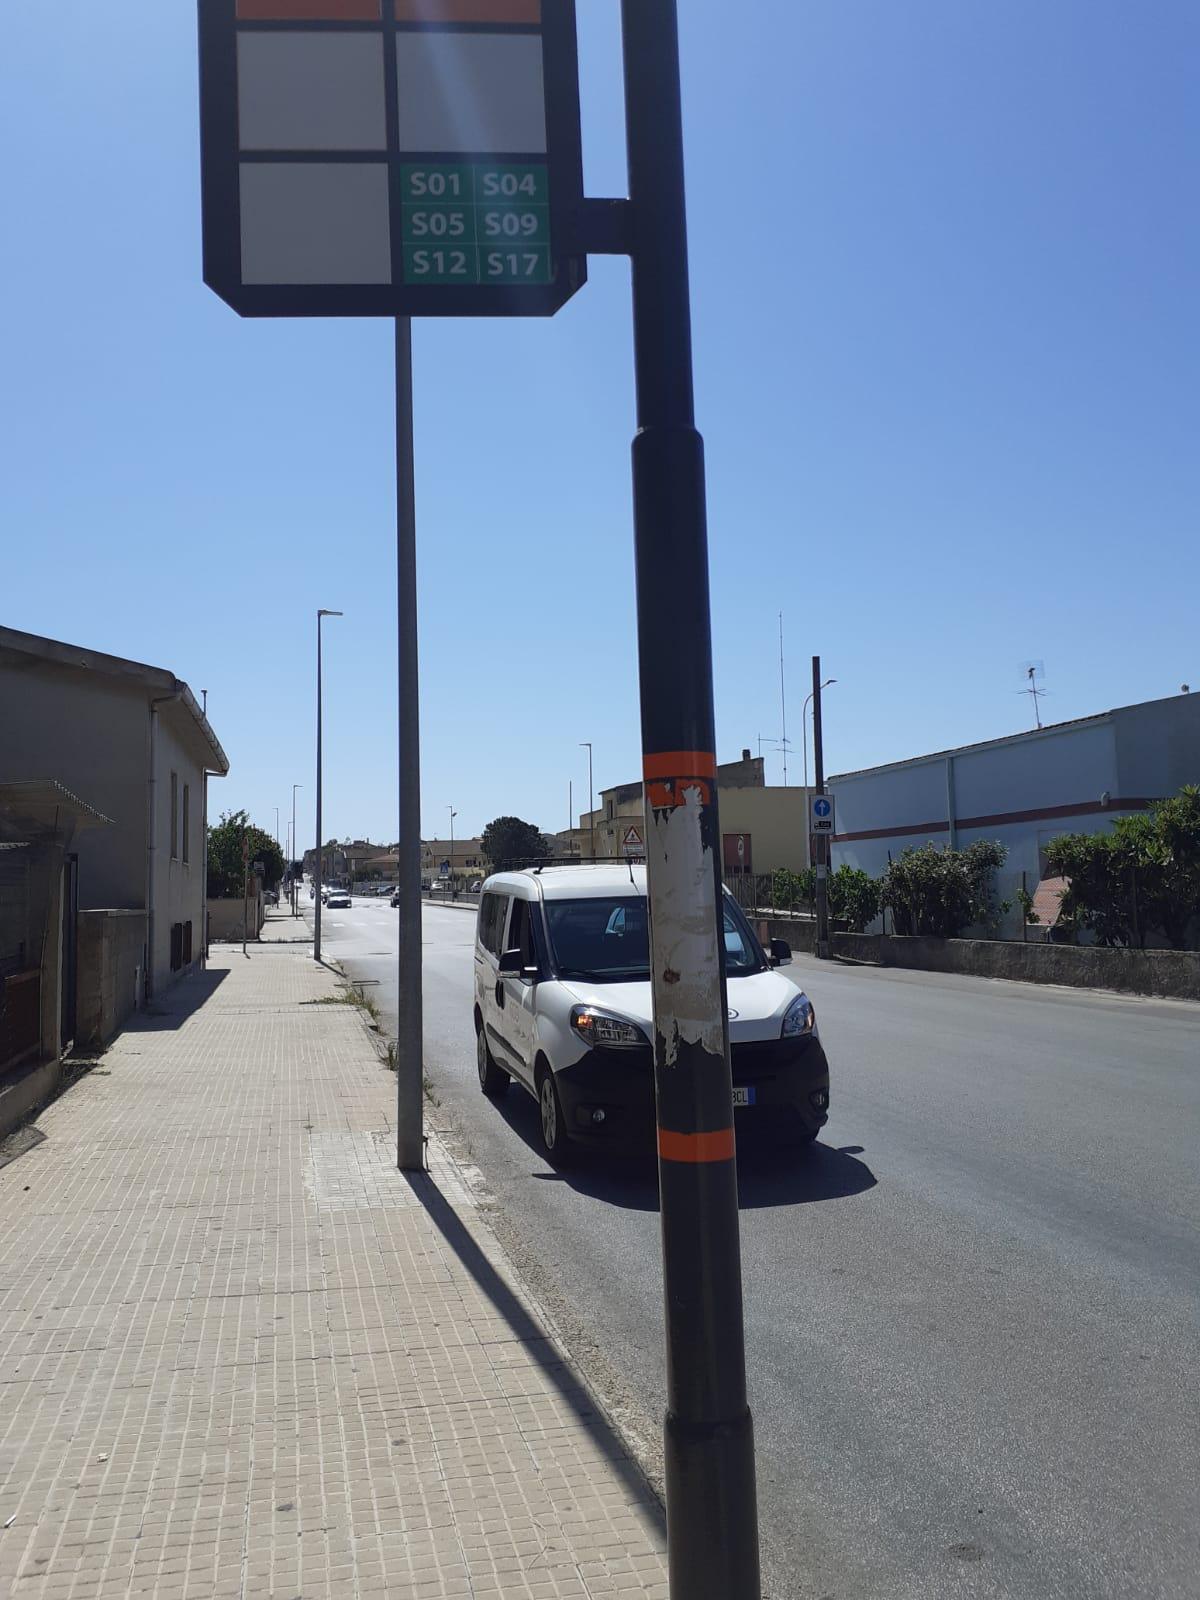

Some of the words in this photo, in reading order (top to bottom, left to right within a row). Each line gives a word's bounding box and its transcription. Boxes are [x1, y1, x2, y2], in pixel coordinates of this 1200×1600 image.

[410, 172, 460, 196] S01
[483, 172, 536, 196] S04
[411, 212, 465, 236] S05
[484, 212, 538, 236] S09
[412, 251, 467, 274] S12
[487, 252, 539, 276] S17
